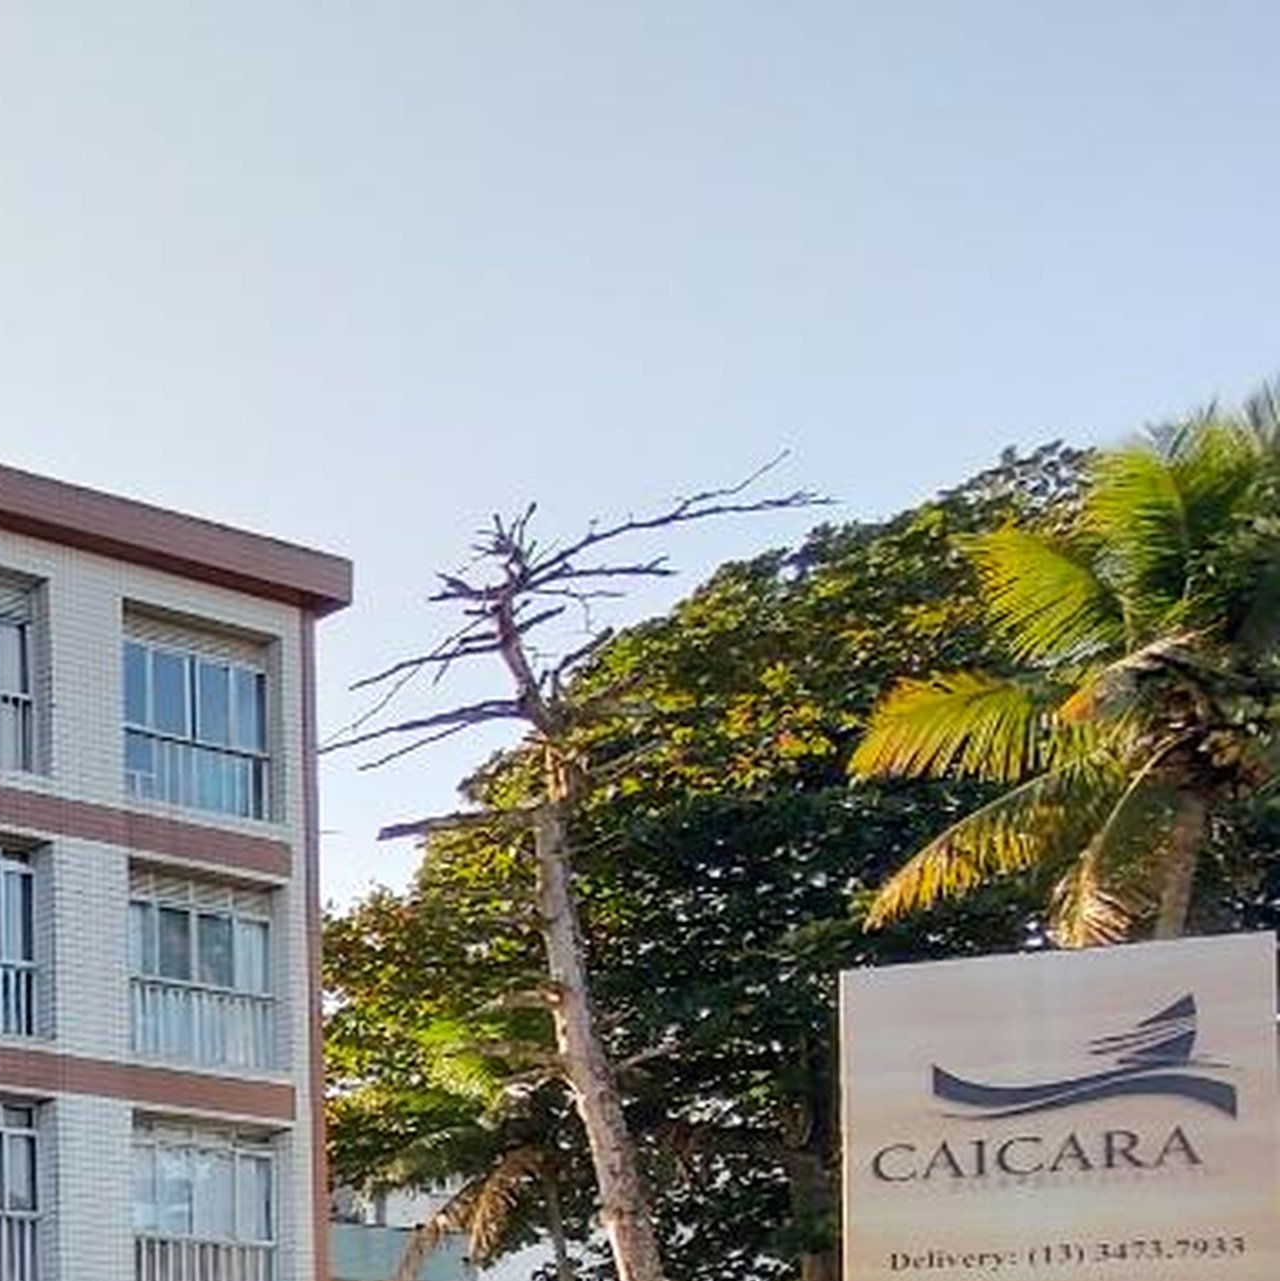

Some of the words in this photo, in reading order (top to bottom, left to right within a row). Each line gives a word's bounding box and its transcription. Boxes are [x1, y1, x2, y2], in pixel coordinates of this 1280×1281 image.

[887, 1249, 1018, 1273] Delivery:
[1028, 1241, 1085, 1267] (13)
[1095, 1235, 1246, 1263] 3473.7933
